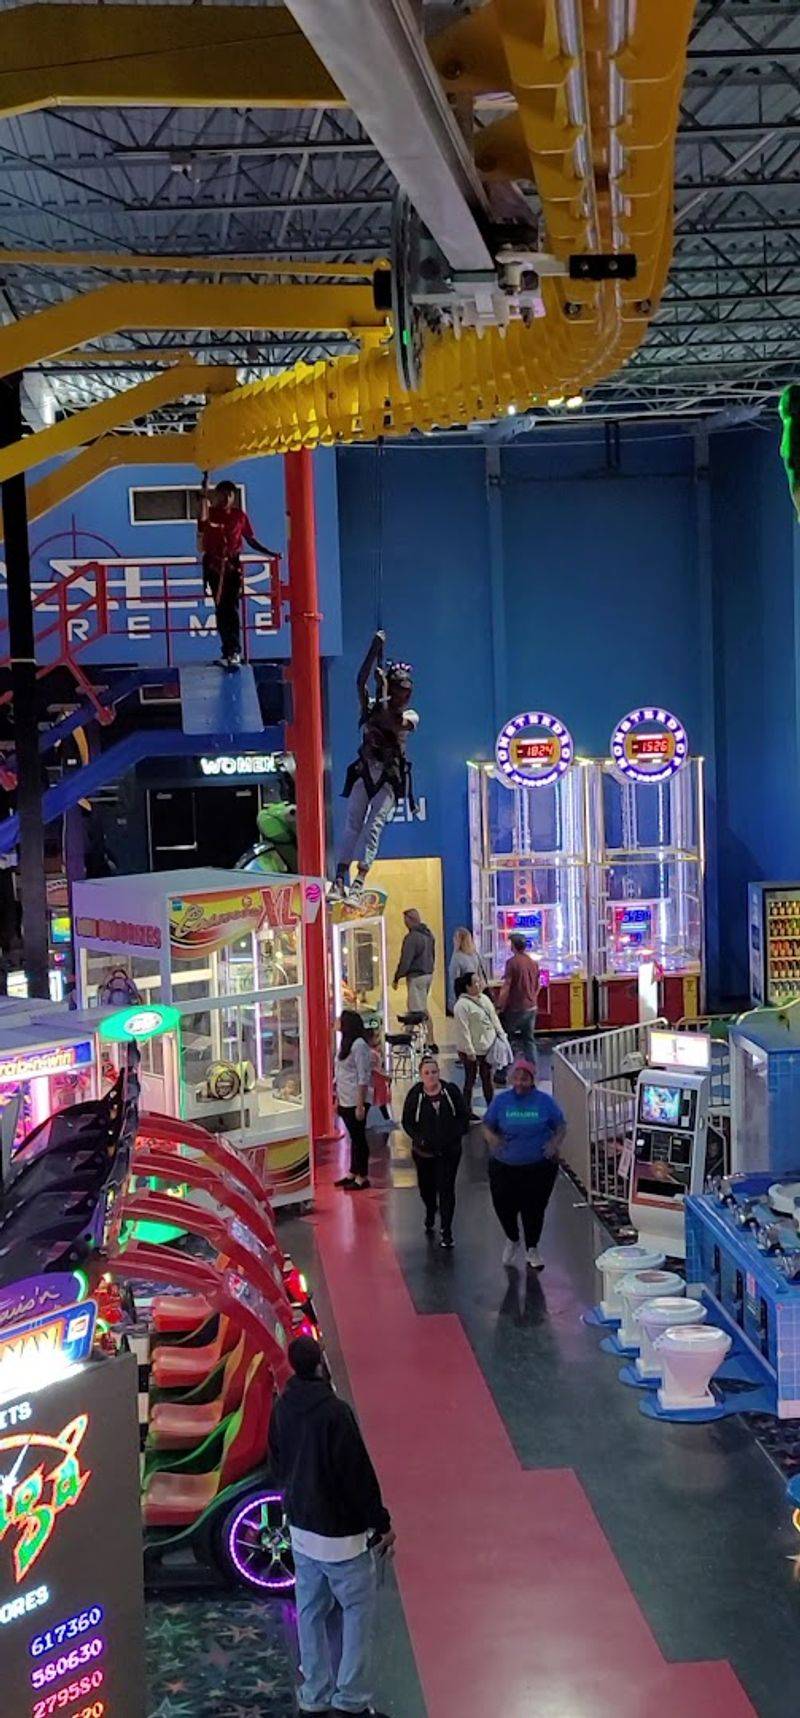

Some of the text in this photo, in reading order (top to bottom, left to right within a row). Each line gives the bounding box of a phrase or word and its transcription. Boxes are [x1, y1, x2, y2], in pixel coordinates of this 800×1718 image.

[201, 756, 276, 775] WOMEN
[257, 886, 299, 929] XL
[0, 1585, 49, 1624] ORES
[31, 1608, 101, 1656] 617360
[32, 1639, 102, 1688] 580630
[33, 1670, 103, 1718] 279580
